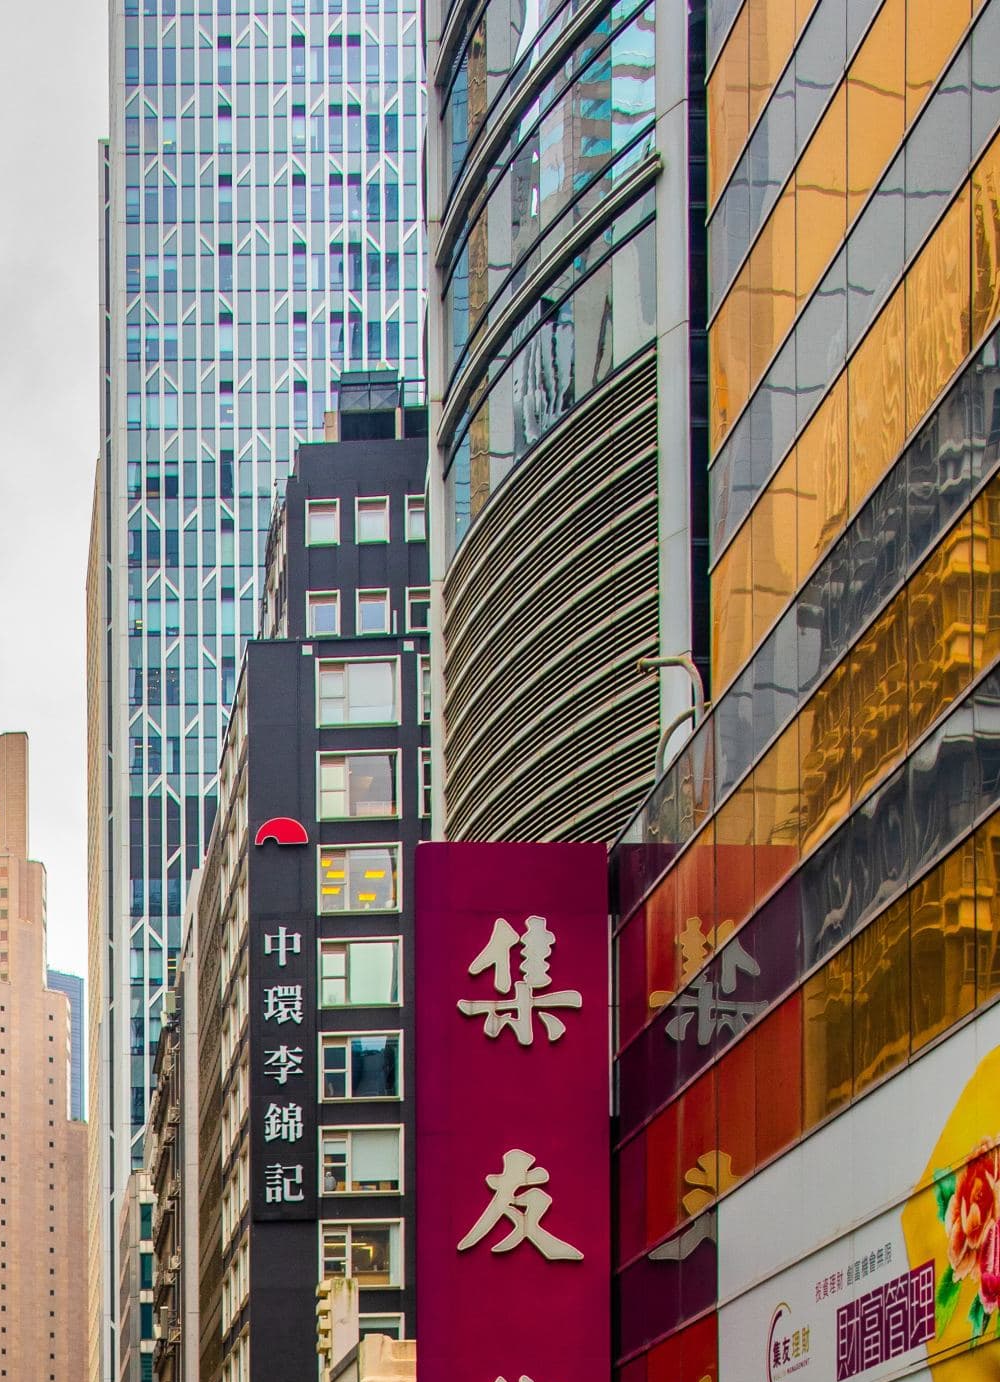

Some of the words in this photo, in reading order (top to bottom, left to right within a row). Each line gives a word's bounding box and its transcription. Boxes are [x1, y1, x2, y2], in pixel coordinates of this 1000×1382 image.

[263, 926, 304, 1203] 中環李錦記
[837, 1263, 936, 1381] 財富管理
